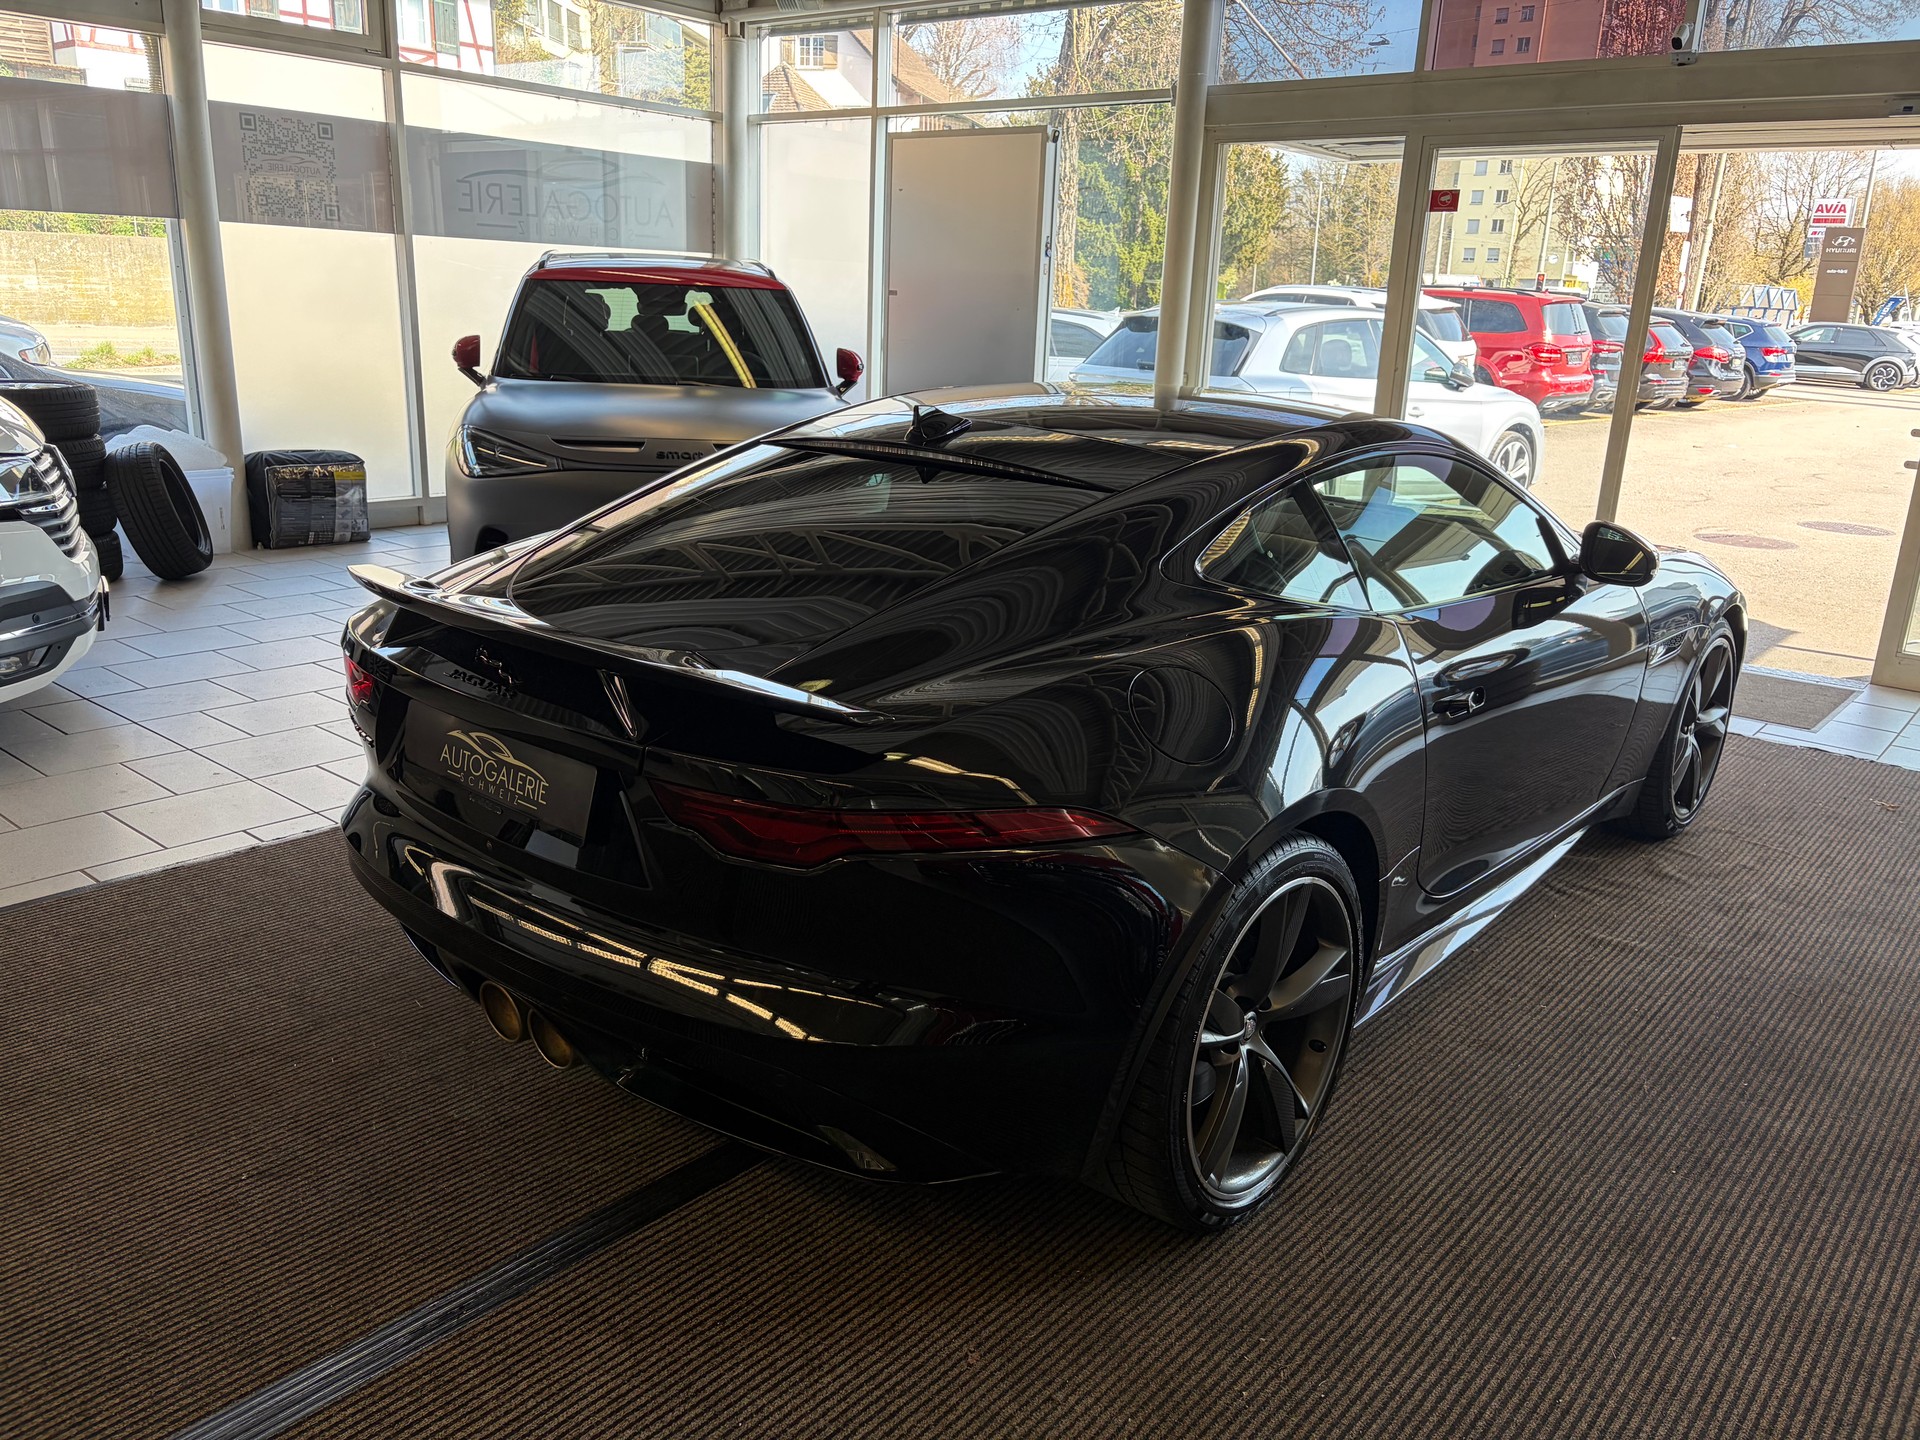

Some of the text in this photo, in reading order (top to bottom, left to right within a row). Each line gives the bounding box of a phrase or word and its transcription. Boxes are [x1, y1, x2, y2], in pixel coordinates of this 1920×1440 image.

[1815, 201, 1847, 214] AVIA
[656, 450, 704, 461] smart
[440, 743, 549, 805] AUTOGALERIE
[460, 772, 519, 806] SCHWEIZ
